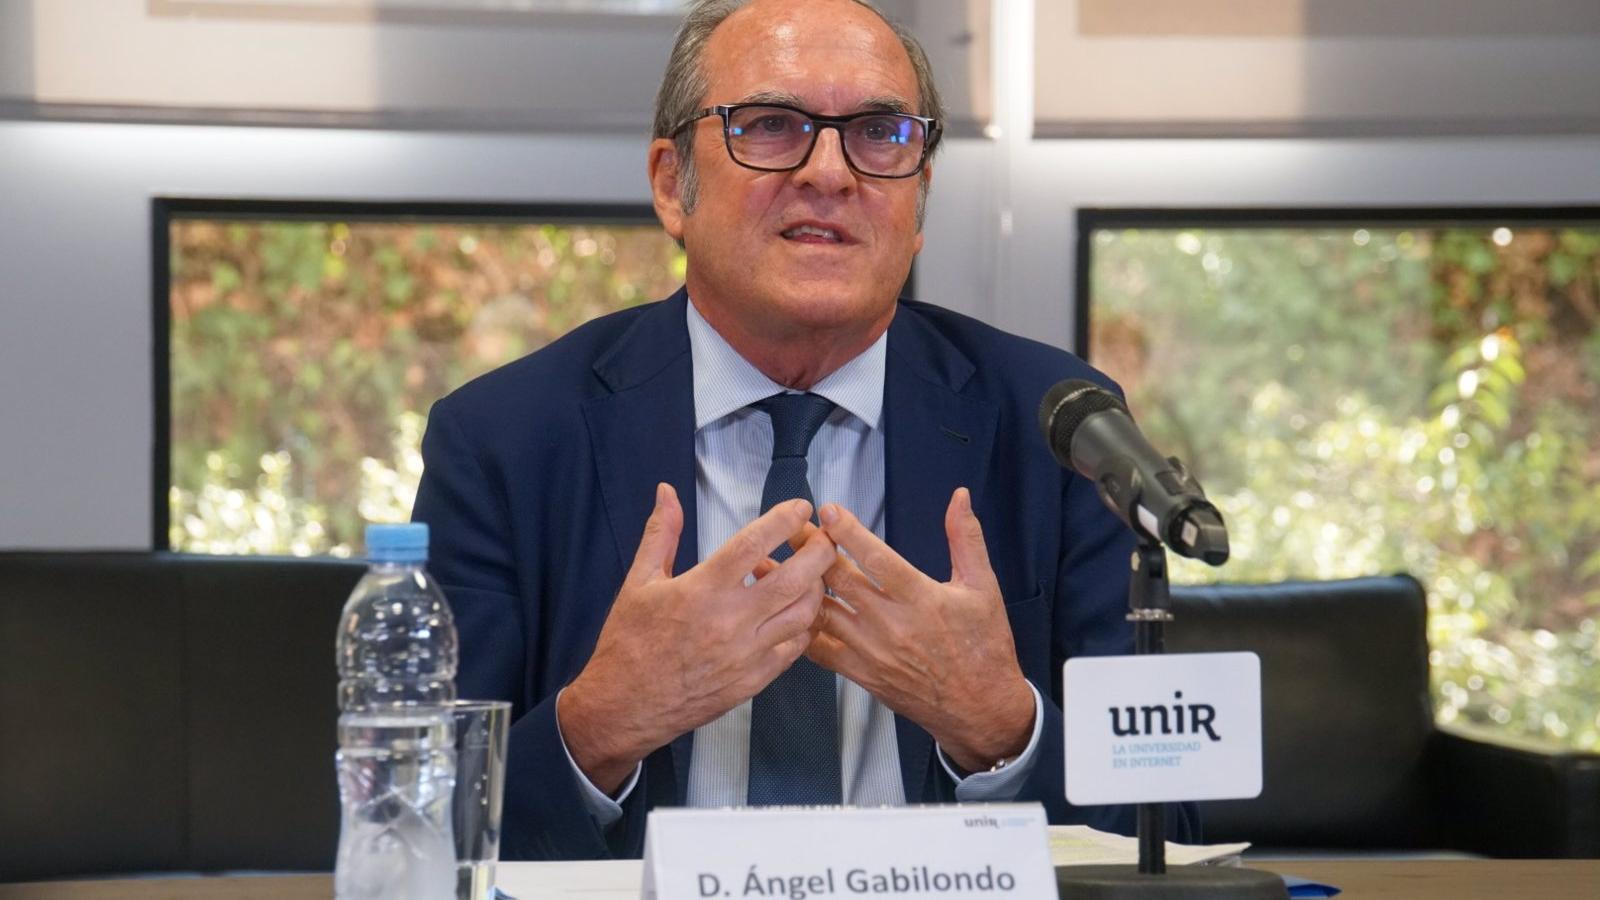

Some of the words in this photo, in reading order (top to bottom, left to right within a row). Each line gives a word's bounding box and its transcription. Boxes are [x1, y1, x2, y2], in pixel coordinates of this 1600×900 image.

[1112, 744, 1126, 755] LA
[1129, 741, 1201, 755] UNIVERSIDAD
[1112, 757, 1127, 769] EN
[1130, 756, 1183, 768] INTERNET
[698, 872, 731, 898] D.
[743, 865, 835, 900] Ángel
[846, 865, 1016, 895] Gabilondo
